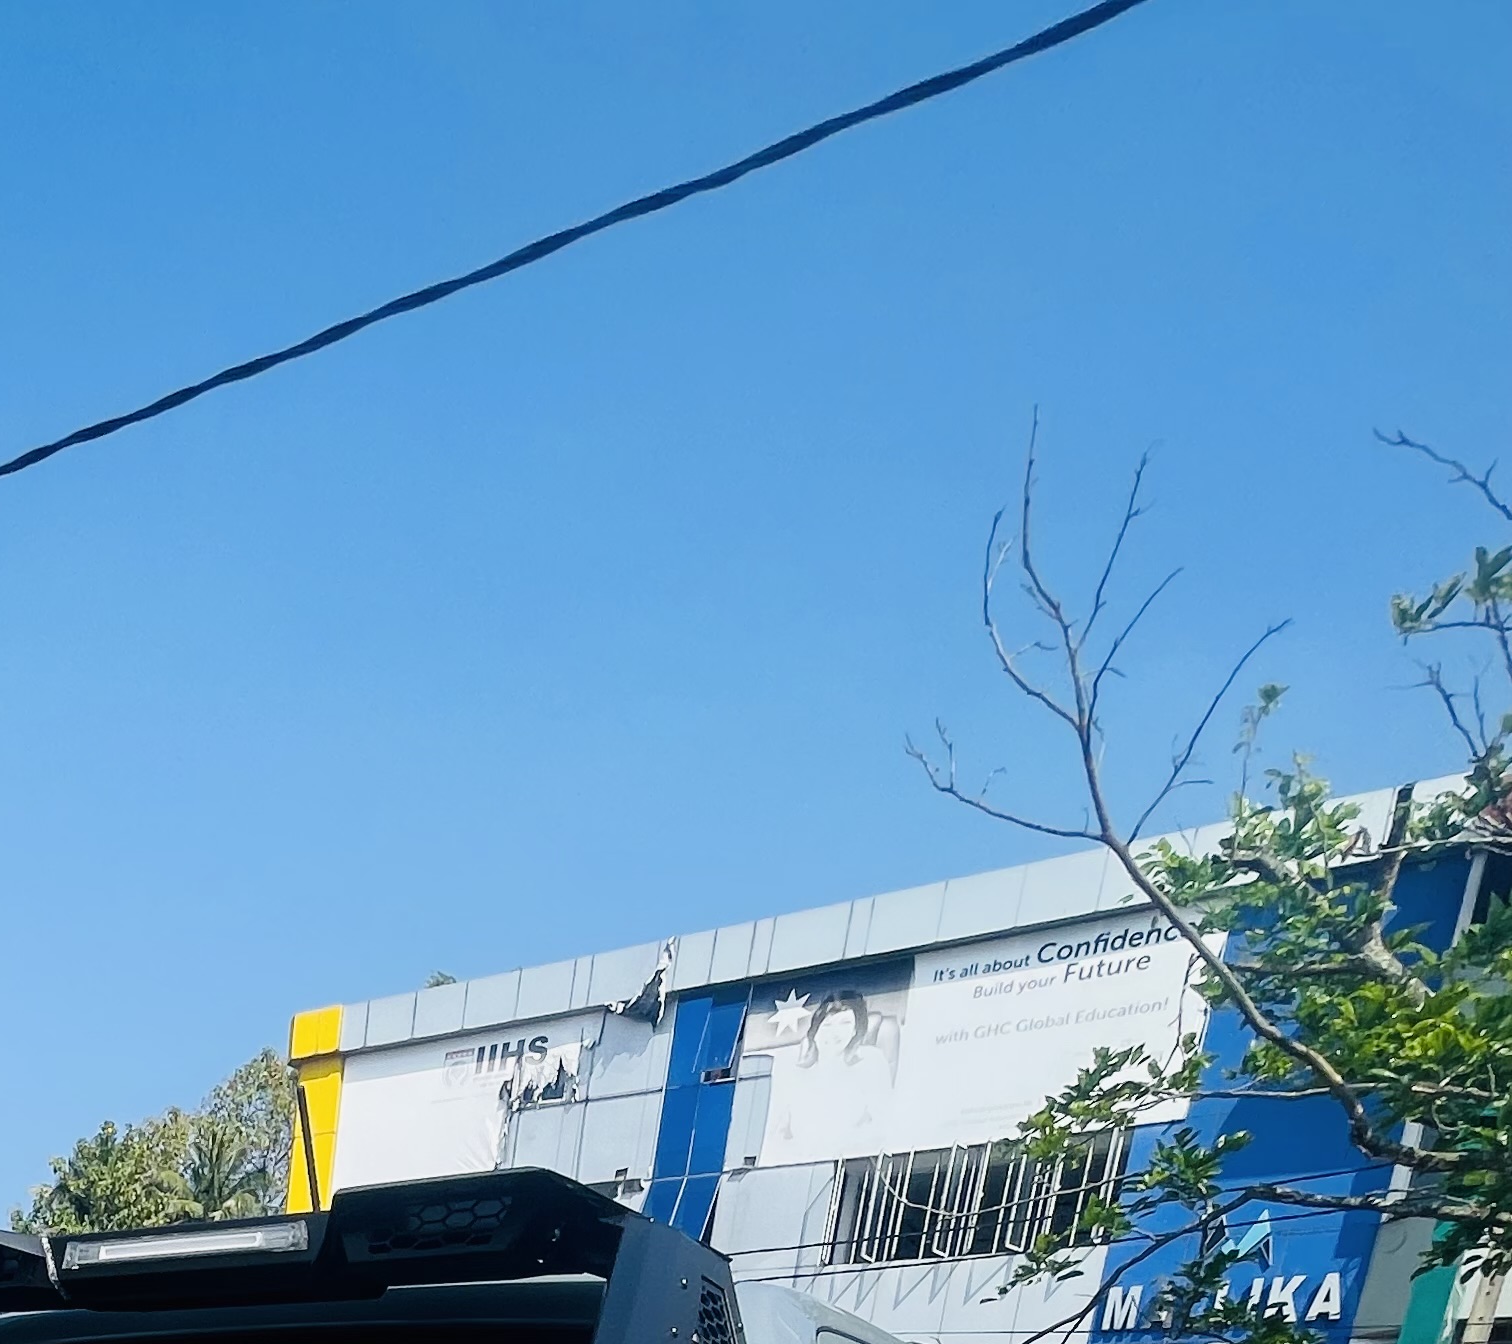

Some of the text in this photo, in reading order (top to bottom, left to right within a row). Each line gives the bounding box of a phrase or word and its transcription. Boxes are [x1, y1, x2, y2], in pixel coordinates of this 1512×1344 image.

[933, 925, 1182, 983] It's all about Confidenc
[972, 954, 1151, 999] Build your Future
[936, 997, 1169, 1046] with GHC Global Education!
